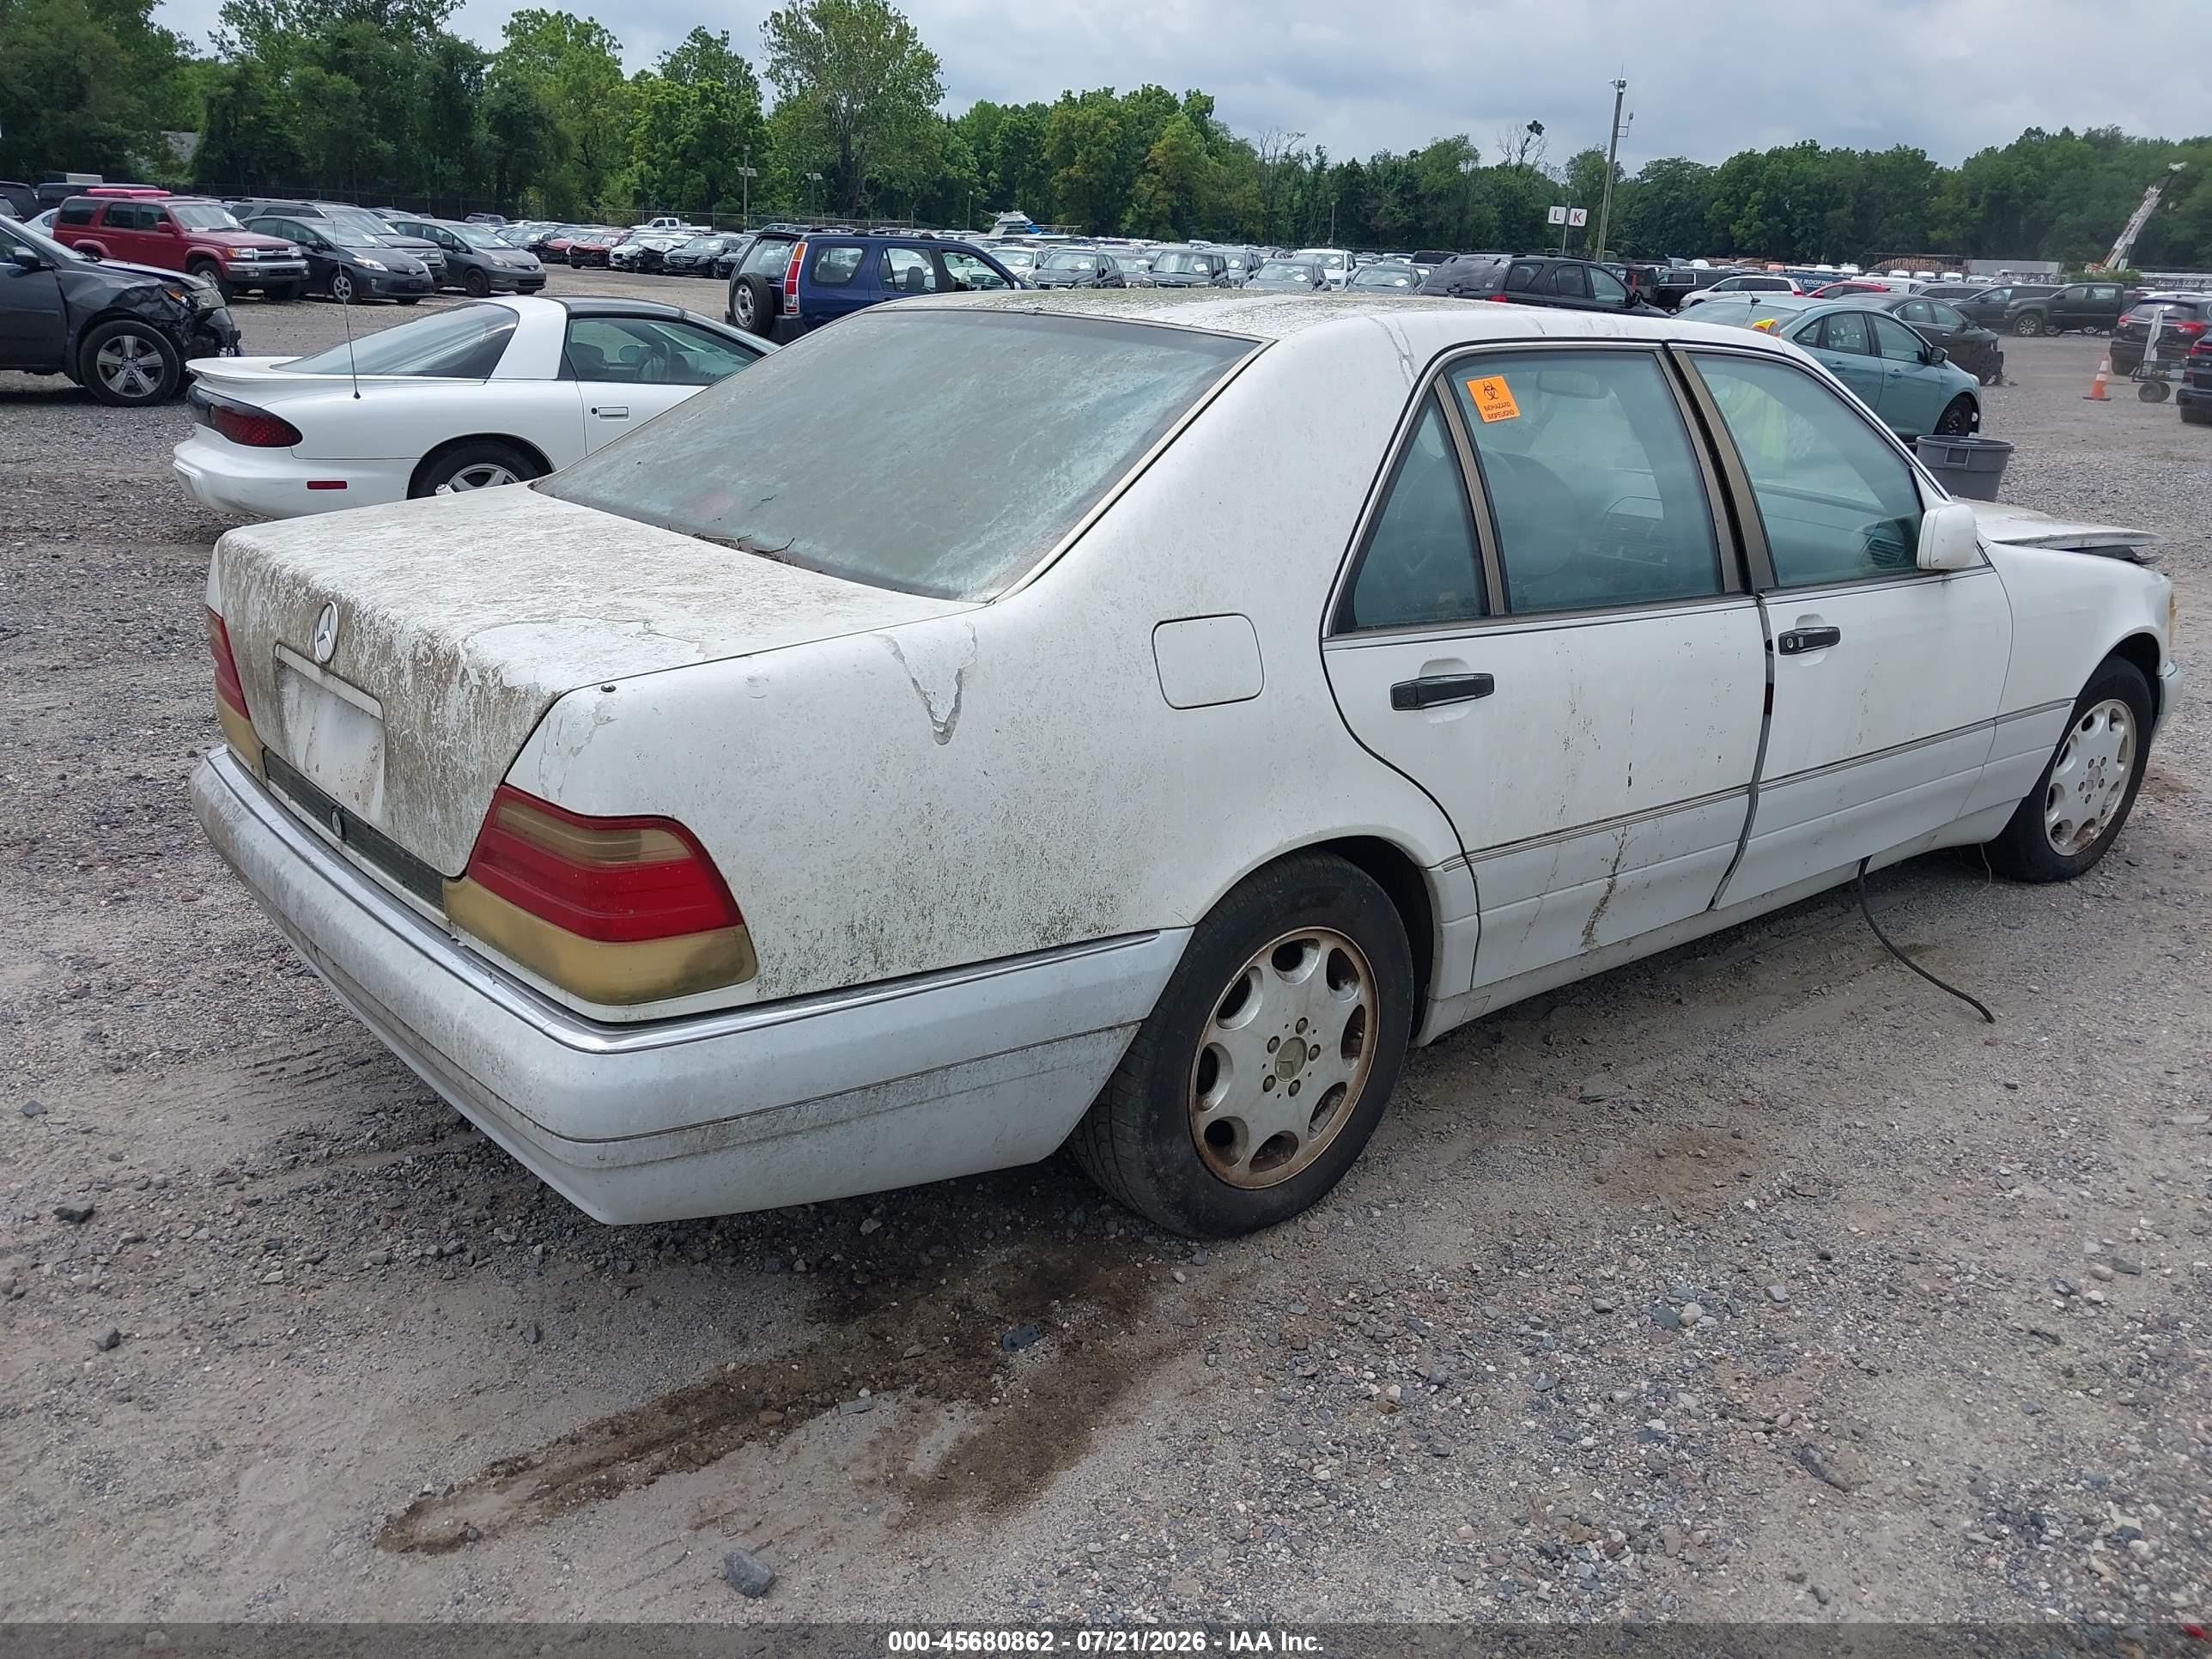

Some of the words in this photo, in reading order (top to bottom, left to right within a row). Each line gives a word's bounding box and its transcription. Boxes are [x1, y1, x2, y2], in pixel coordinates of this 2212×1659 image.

[1553, 210, 1560, 221] L
[1573, 211, 1583, 223] K
[1484, 402, 1511, 411] BIOHAZARD
